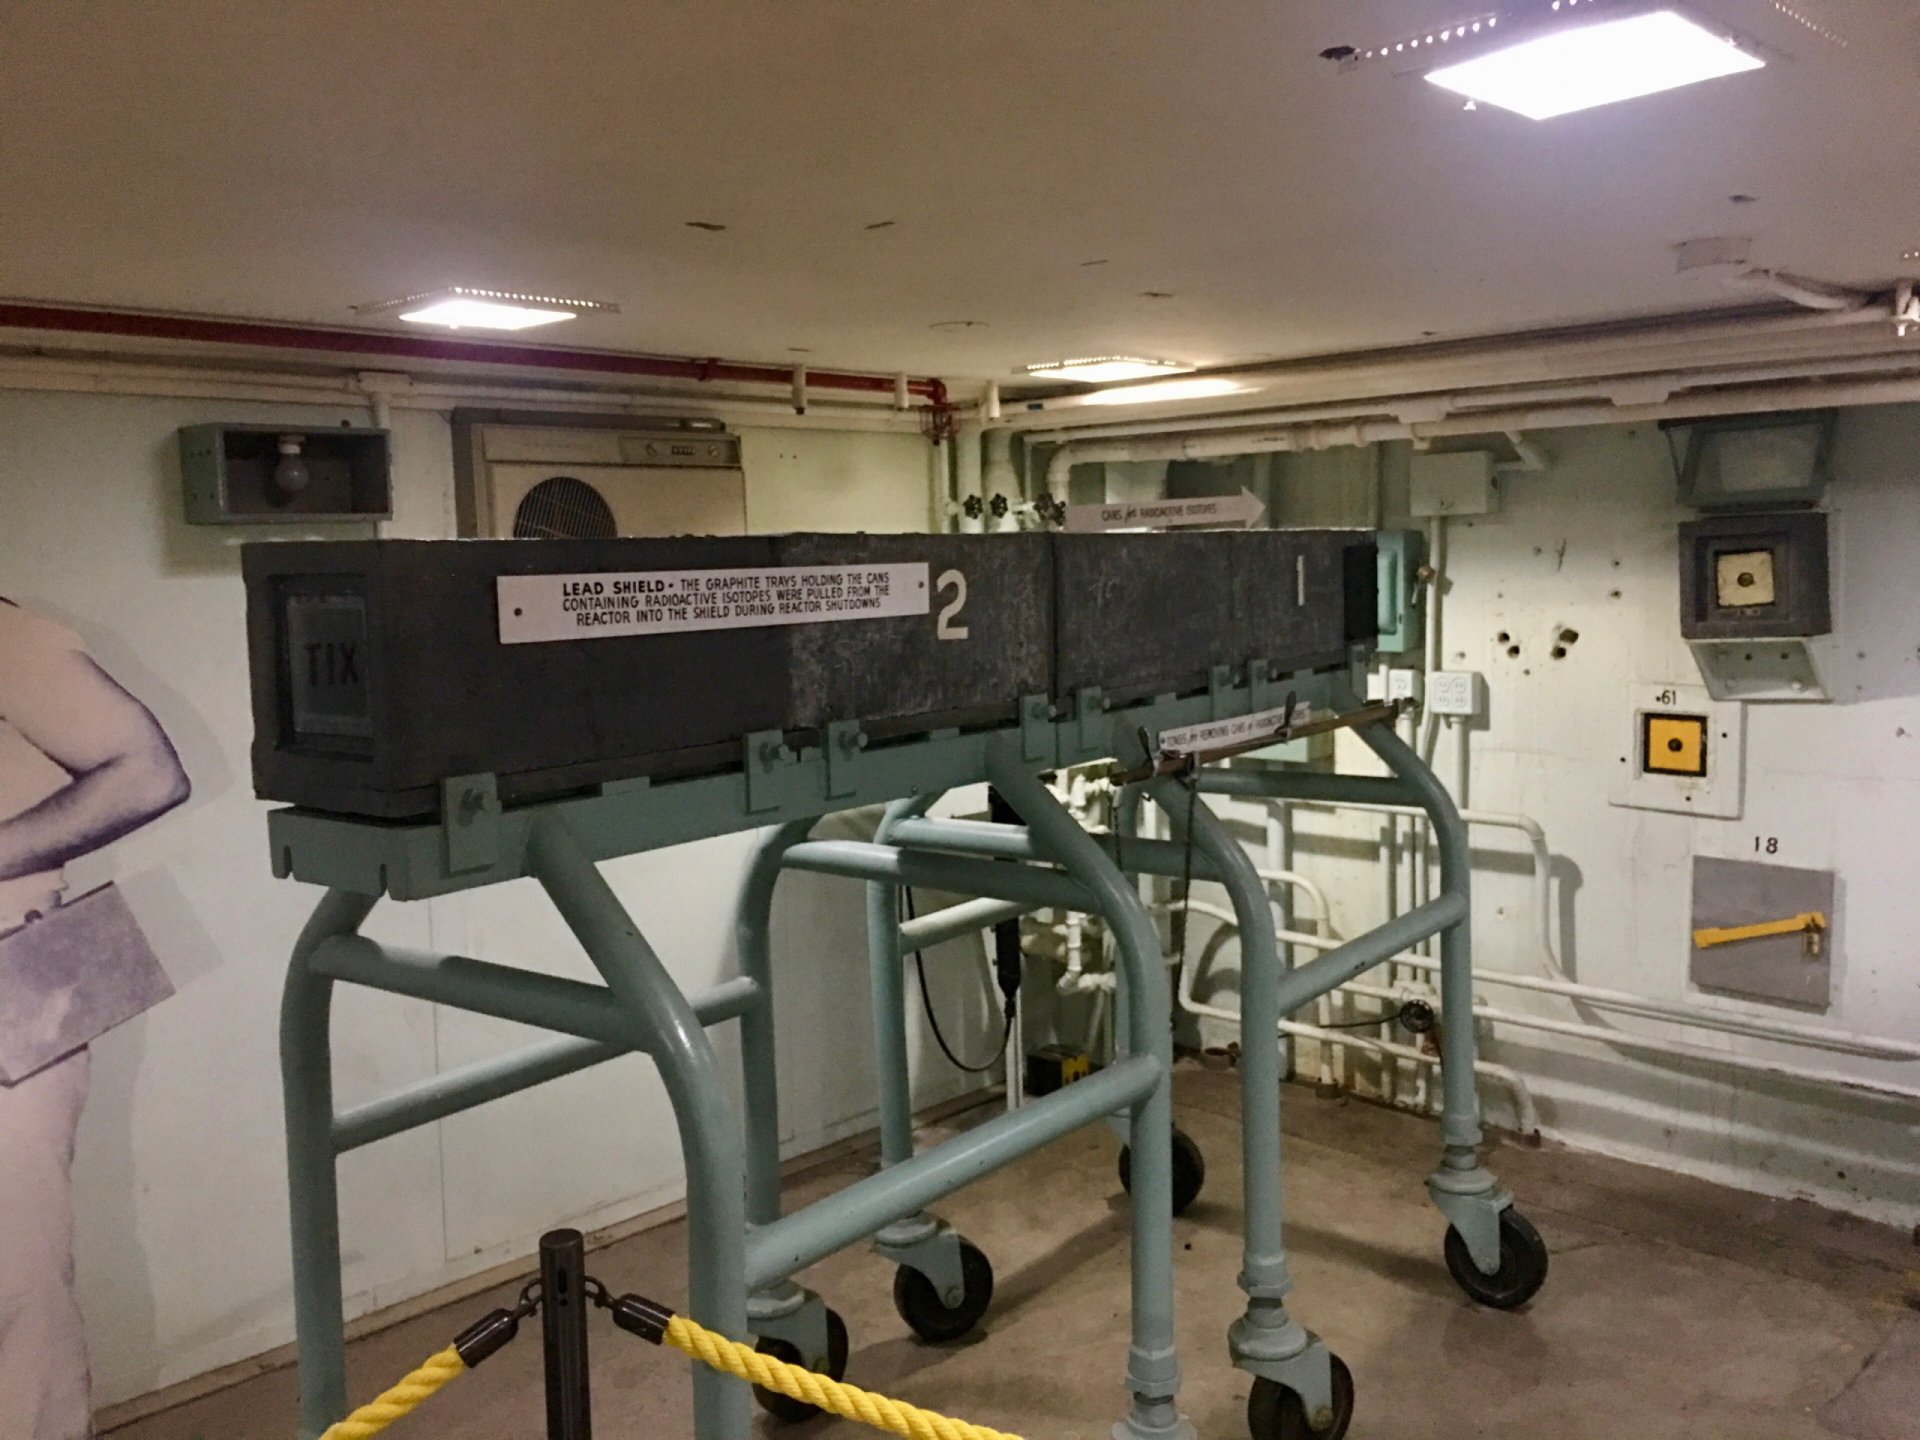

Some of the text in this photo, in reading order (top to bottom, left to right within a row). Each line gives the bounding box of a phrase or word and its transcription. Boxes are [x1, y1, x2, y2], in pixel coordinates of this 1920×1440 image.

[563, 582, 604, 597] LEAD
[681, 578, 700, 592] THE
[705, 576, 760, 591] GRAPHITE
[766, 575, 797, 589] TRAYS
[801, 573, 843, 587] HOLDING
[847, 572, 863, 585] THE
[866, 571, 890, 584] CANS
[563, 584, 890, 612] CONTAINING RADIOACTIVE ISOTOPES WERE PULLED FROM THE
[576, 597, 881, 627] REACTOR INTO THE SHIELD DURING REACTOR SHUTDOWNS
[936, 569, 969, 640] 2
[304, 642, 359, 687] TIX
[1661, 690, 1677, 705] 61
[1754, 836, 1779, 854] 18
